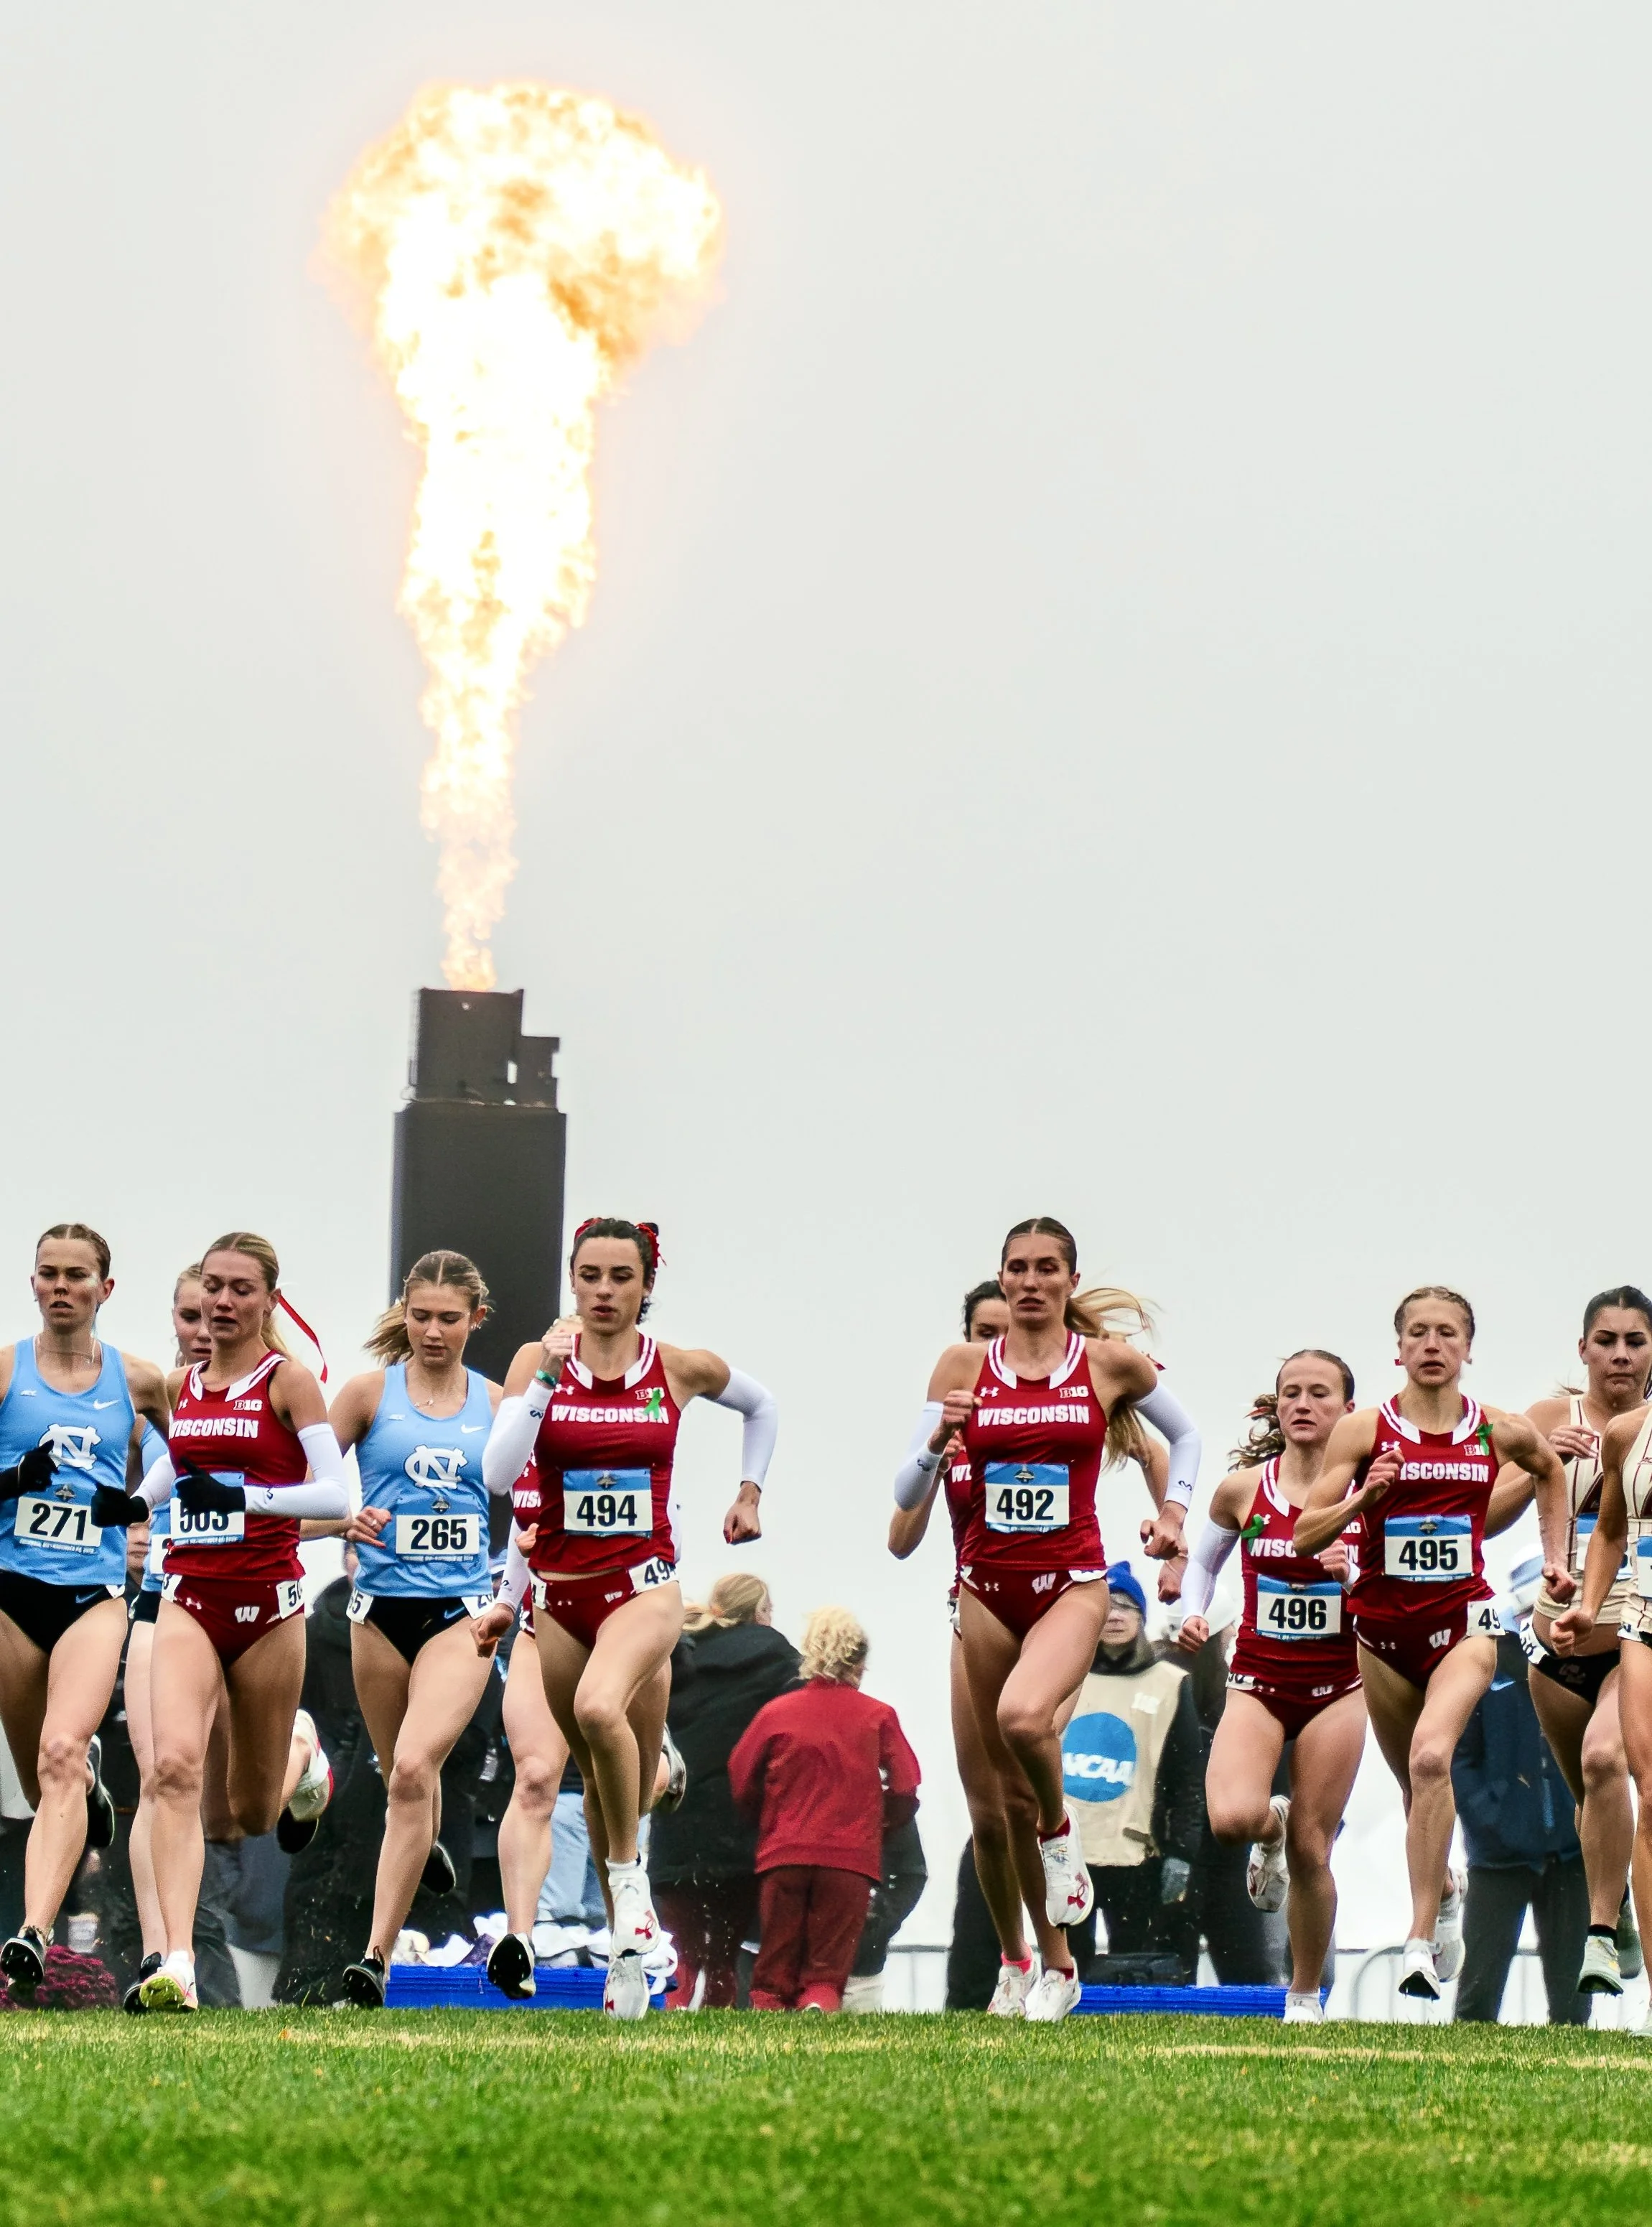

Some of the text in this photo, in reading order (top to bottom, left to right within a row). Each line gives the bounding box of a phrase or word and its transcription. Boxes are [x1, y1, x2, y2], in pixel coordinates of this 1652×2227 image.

[169, 1418, 258, 1440] WISCONSIN
[551, 1405, 669, 1424] WISCONSIN
[978, 1405, 1090, 1427] WISCONSIN
[1400, 1462, 1489, 1482] ISCONSIN
[577, 1494, 637, 1527] 494
[997, 1489, 1054, 1521] 492
[30, 1503, 87, 1541] 271
[411, 1518, 467, 1550] 265
[1399, 1539, 1458, 1571] 495
[1269, 1598, 1327, 1630] 496
[1063, 1752, 1134, 1787] NCAA
